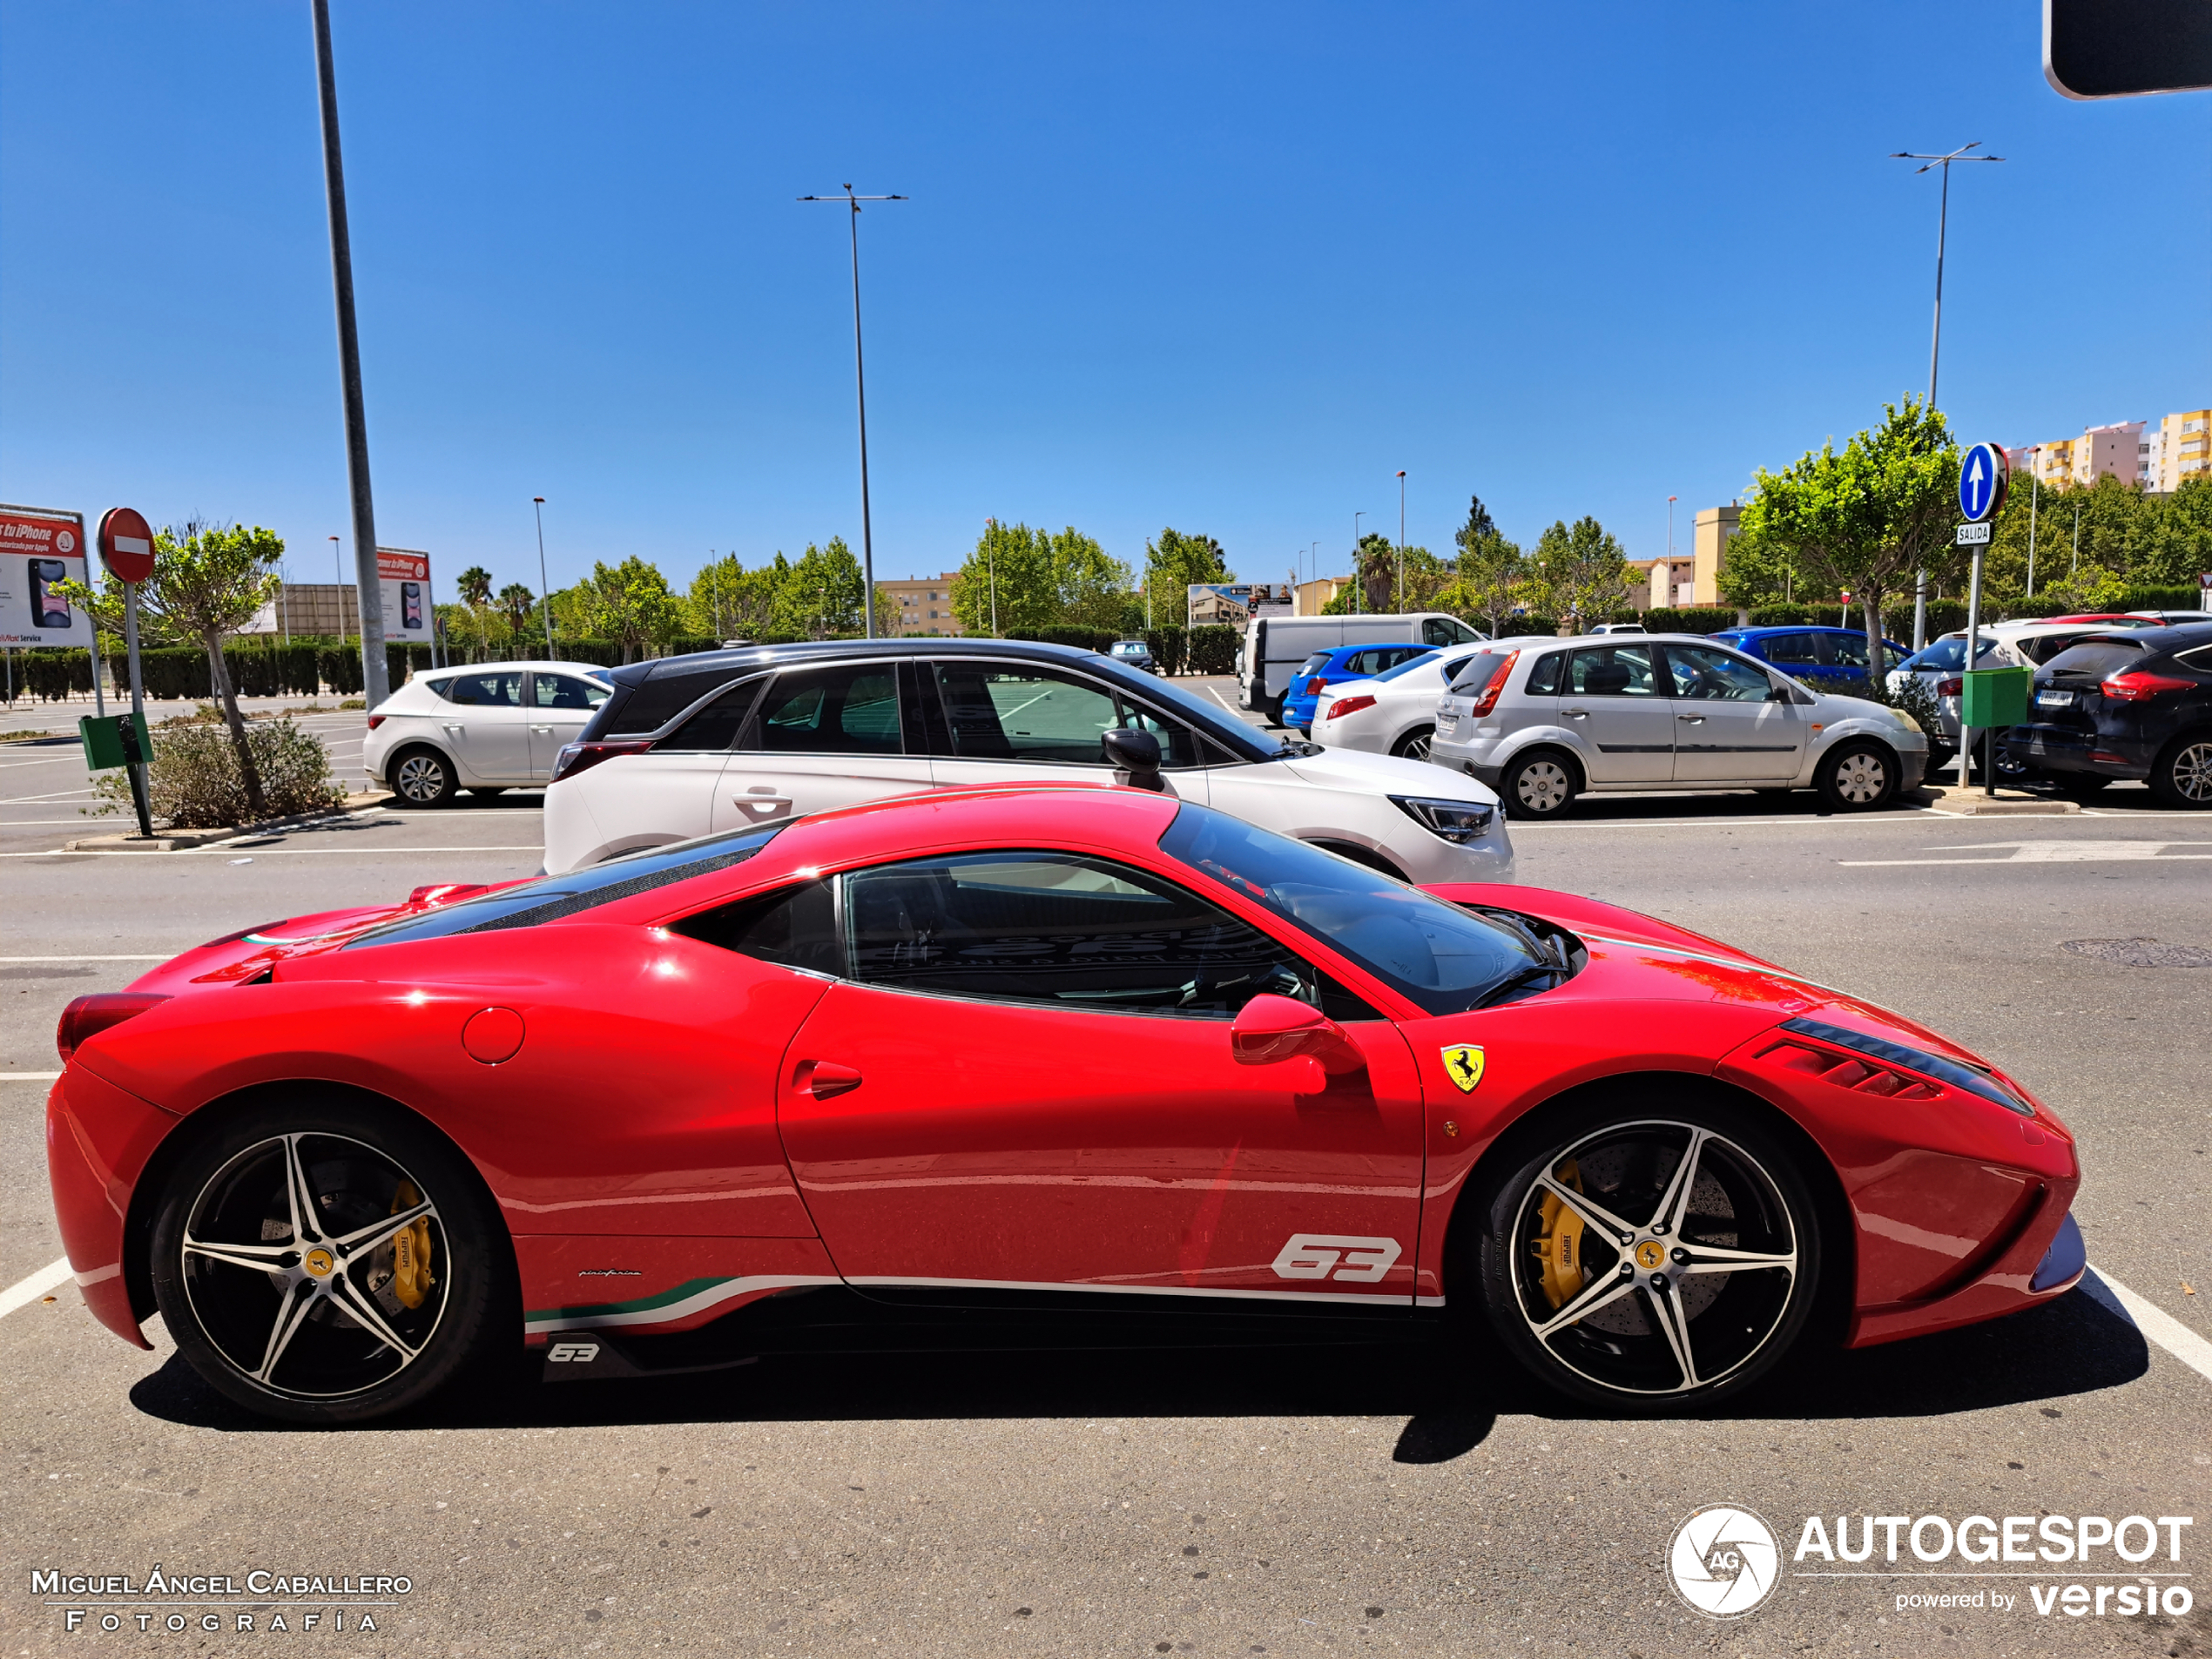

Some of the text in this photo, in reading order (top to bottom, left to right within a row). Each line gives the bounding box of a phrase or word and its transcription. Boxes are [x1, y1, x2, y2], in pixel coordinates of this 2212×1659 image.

[3, 523, 17, 536] tu
[15, 523, 52, 541] iPhone
[1959, 527, 1988, 541] SALIDA
[34, 543, 50, 552] Apple
[401, 1237, 410, 1268] Ferrari
[1271, 1233, 1402, 1283] 63
[1563, 1235, 1572, 1268] Ferrari
[578, 1269, 642, 1278] pininfarina
[548, 1343, 600, 1362] 63
